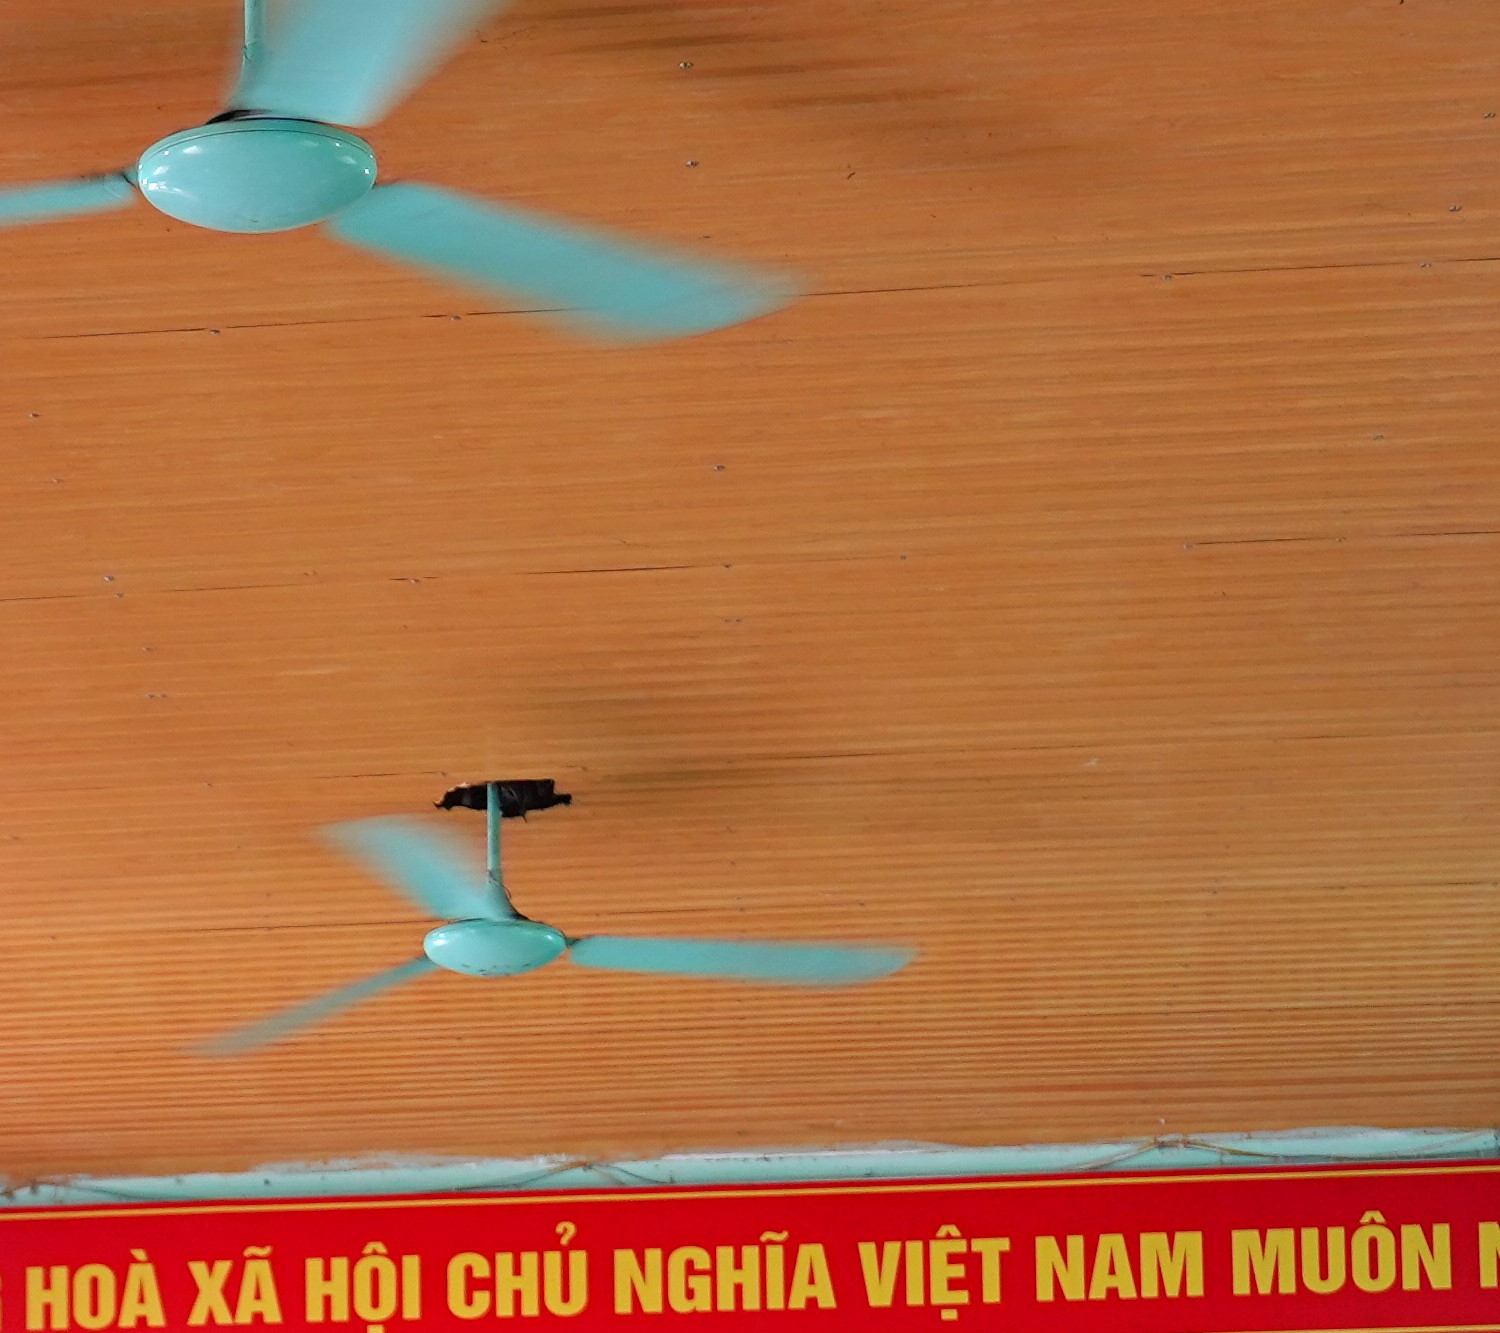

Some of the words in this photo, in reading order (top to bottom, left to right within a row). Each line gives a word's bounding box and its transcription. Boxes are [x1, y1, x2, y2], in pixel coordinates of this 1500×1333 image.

[25, 1248, 167, 1332] HOÀ
[186, 1245, 283, 1327] XÃ
[446, 1220, 589, 1321] CHỦ
[612, 1230, 838, 1316] NGHĨA
[857, 1223, 1012, 1322] VIỆT
[1034, 1230, 1206, 1303] NAM
[1230, 1209, 1453, 1297] MUÔN
